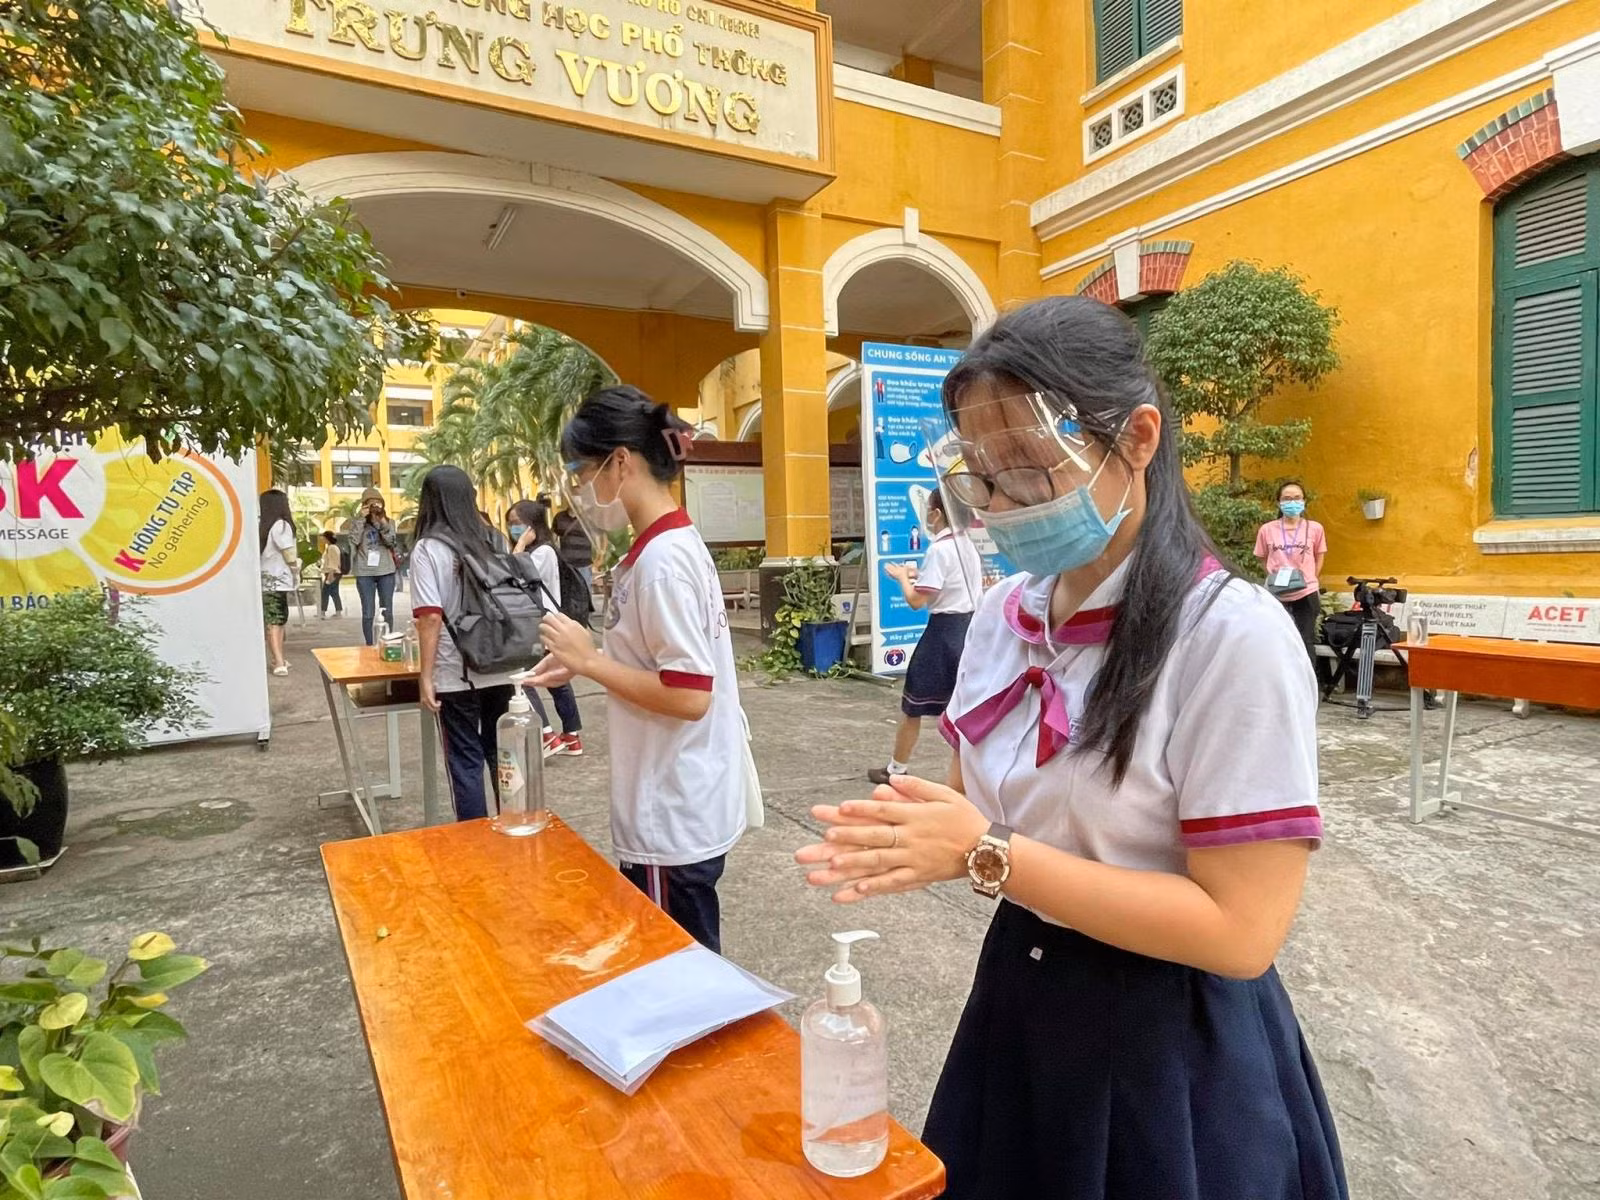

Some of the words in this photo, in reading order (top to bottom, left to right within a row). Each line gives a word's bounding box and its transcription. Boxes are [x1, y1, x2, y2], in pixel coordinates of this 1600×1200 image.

[285, 0, 537, 86] TRƯNG
[555, 48, 761, 135] VƯƠNG
[543, 1, 611, 40] HỌC
[622, 21, 685, 59] PHỔ
[692, 39, 789, 87] THÔNG
[867, 348, 903, 360] CHUNG
[933, 354, 946, 364] AN
[0, 458, 85, 519] K
[169, 471, 197, 497] TẬP
[147, 551, 168, 569] No
[164, 496, 210, 553] gathering
[1528, 605, 1590, 623] ACET
